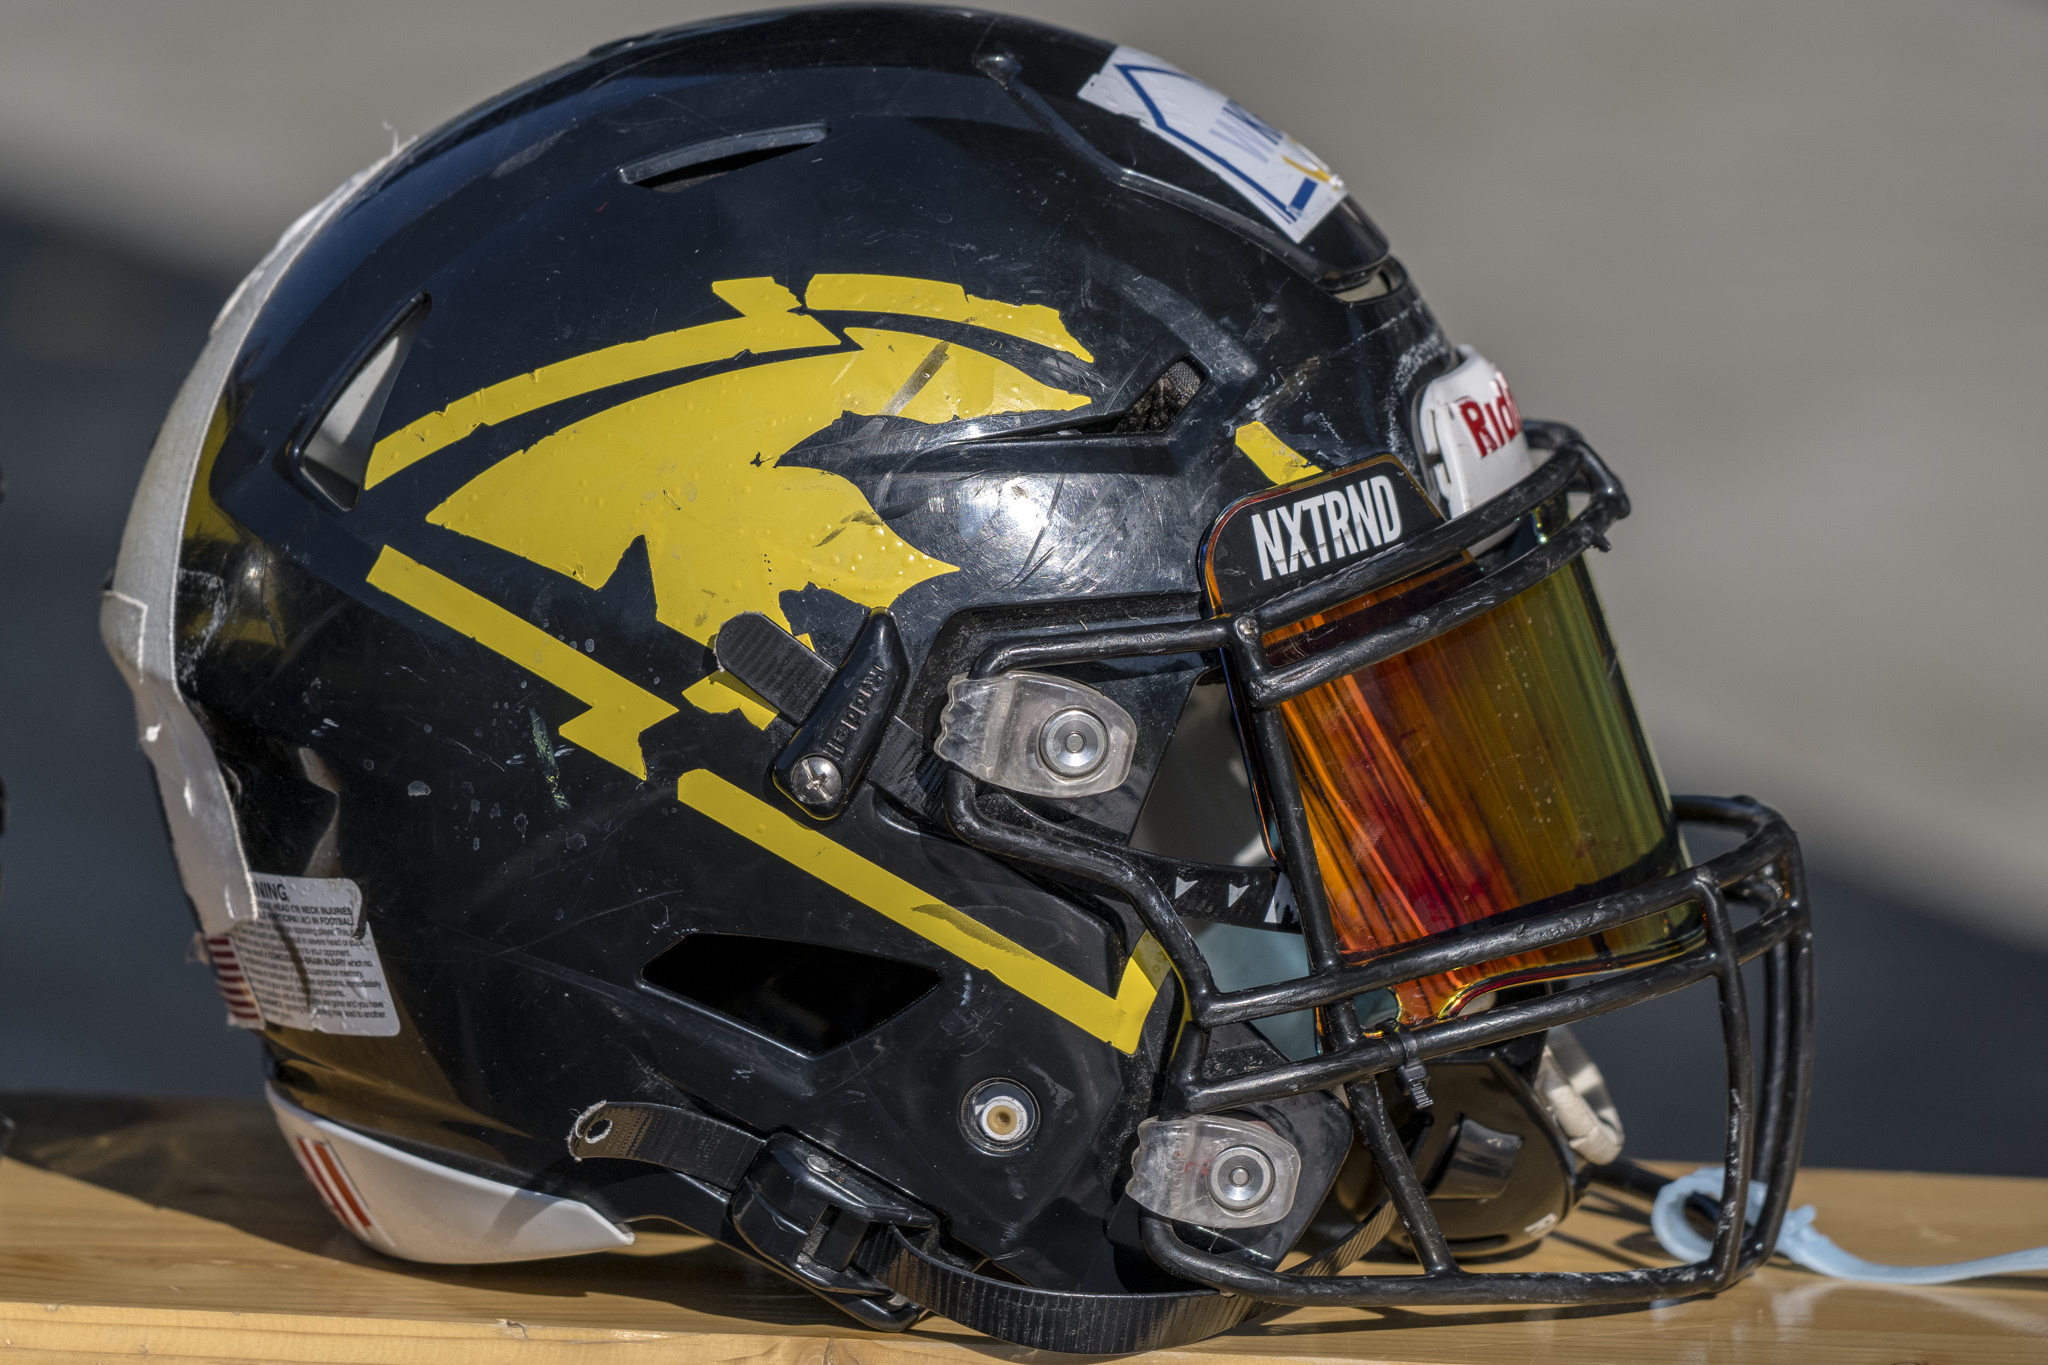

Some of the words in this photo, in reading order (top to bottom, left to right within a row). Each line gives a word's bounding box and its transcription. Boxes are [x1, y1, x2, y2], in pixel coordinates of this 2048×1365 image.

[1459, 376, 1522, 459] Rid
[1251, 474, 1401, 581] NXTRND
[822, 664, 889, 762] Riddell
[254, 881, 288, 901] NING
[301, 905, 320, 914] NECK
[320, 906, 353, 916] INJURIES
[323, 958, 346, 966] INJURY
